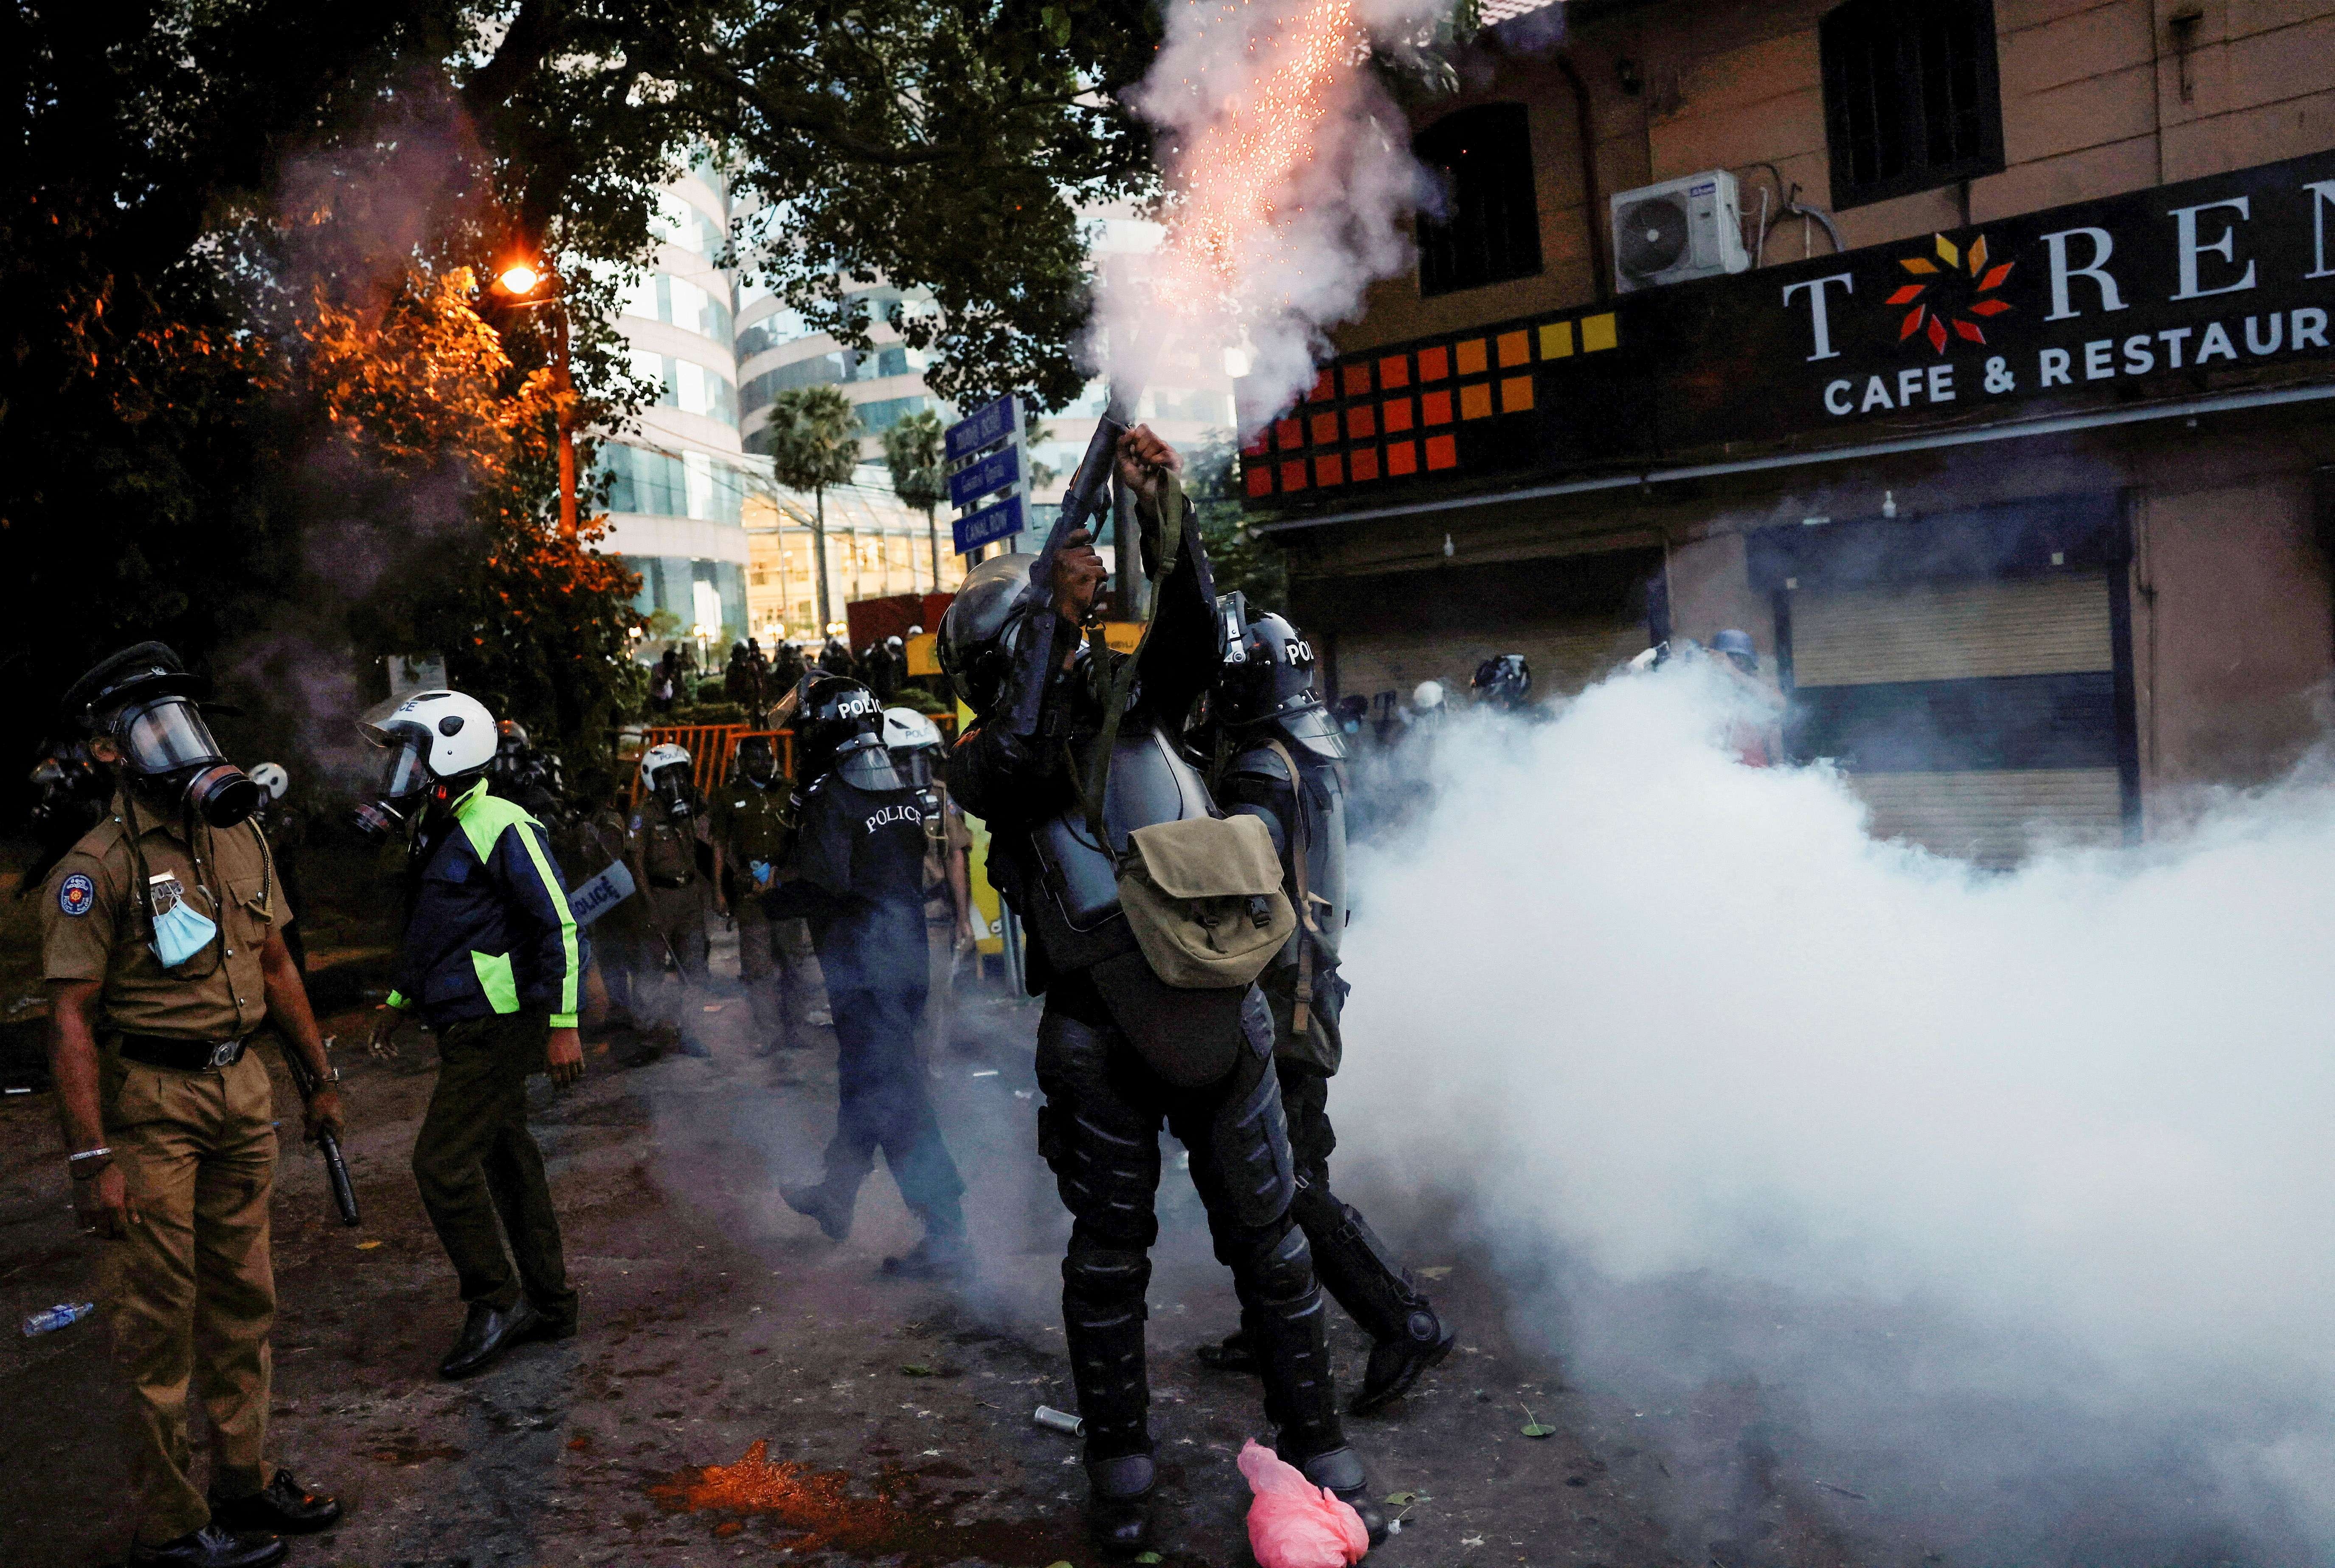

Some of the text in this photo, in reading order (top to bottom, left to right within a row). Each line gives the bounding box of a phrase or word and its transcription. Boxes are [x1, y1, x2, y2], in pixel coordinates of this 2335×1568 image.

[1824, 307, 2330, 416] CAFE & RESTAUR
[865, 806, 921, 834] POLICE
